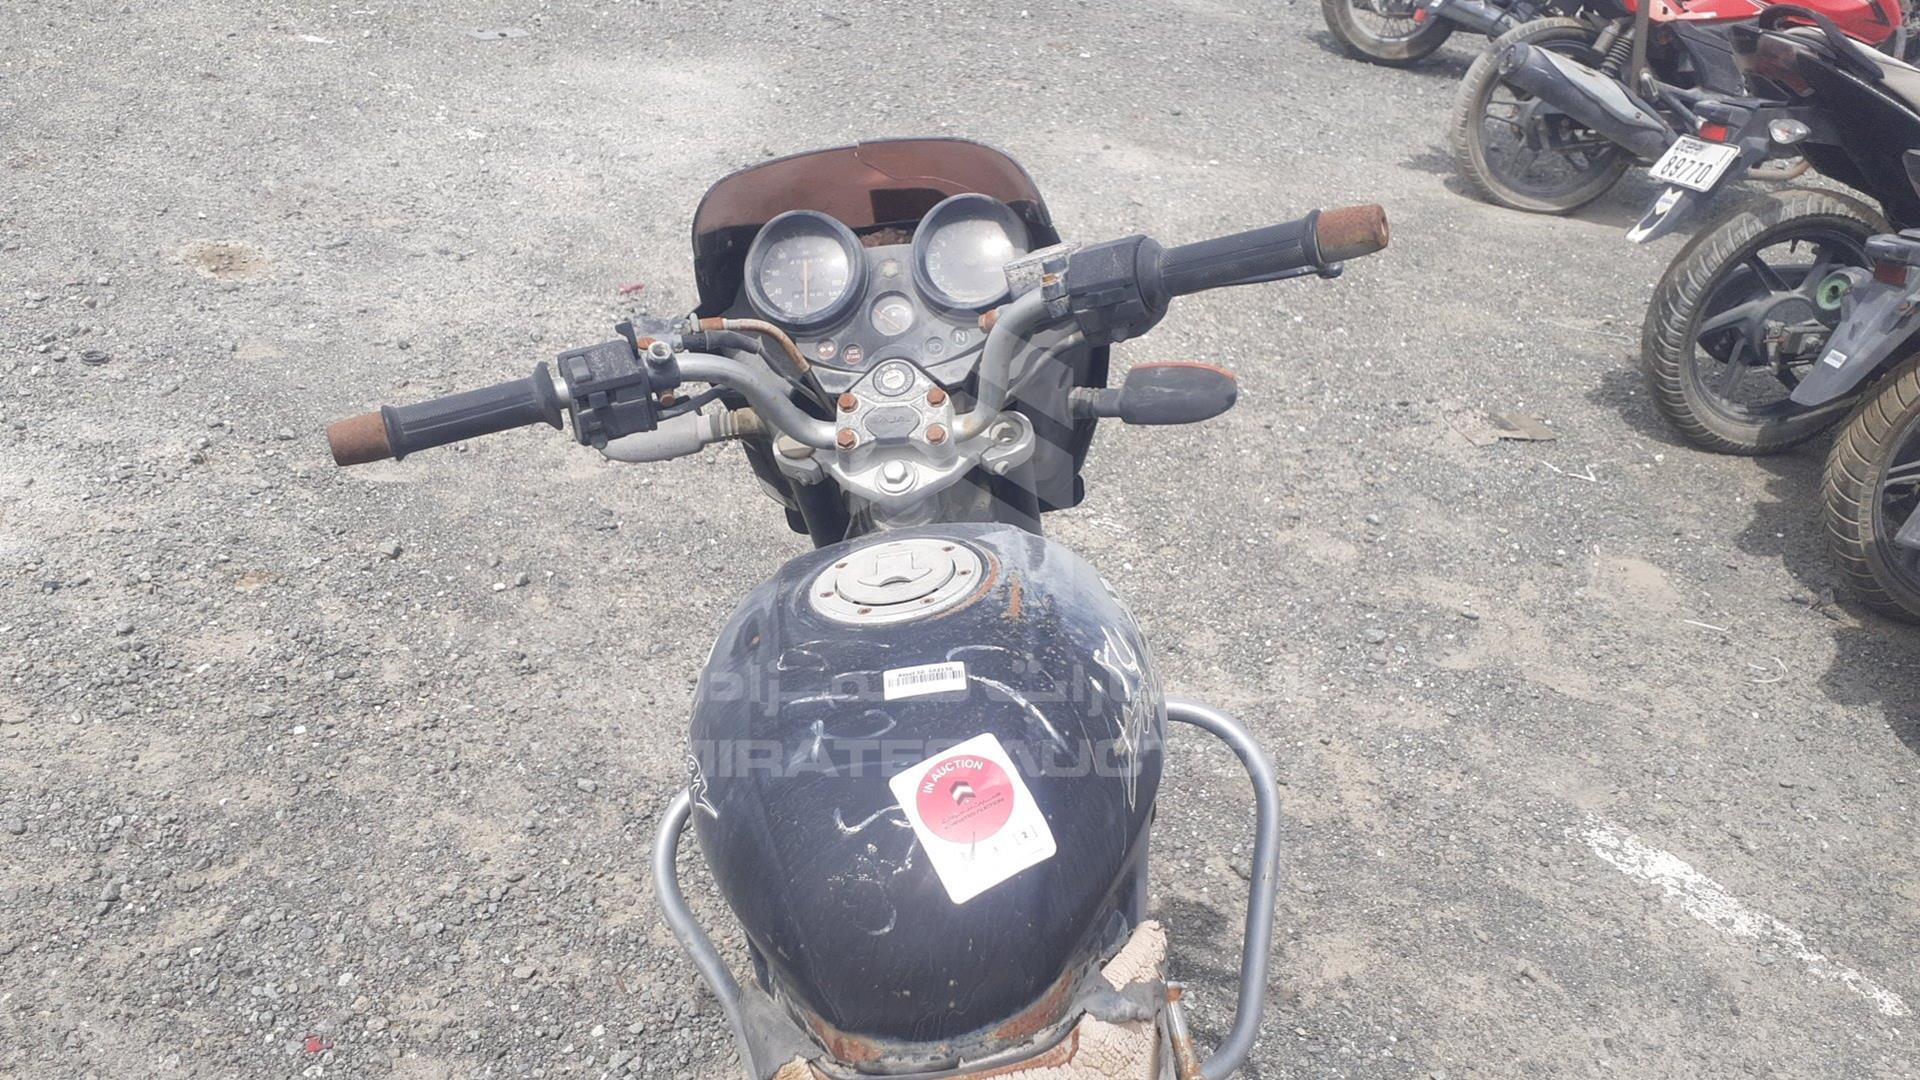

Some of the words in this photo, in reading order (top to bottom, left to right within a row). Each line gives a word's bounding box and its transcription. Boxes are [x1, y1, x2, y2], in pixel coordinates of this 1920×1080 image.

[1660, 155, 1714, 184] 89770
[956, 332, 966, 343] N
[922, 781, 936, 795] IN
[932, 759, 984, 783] AUCTION
